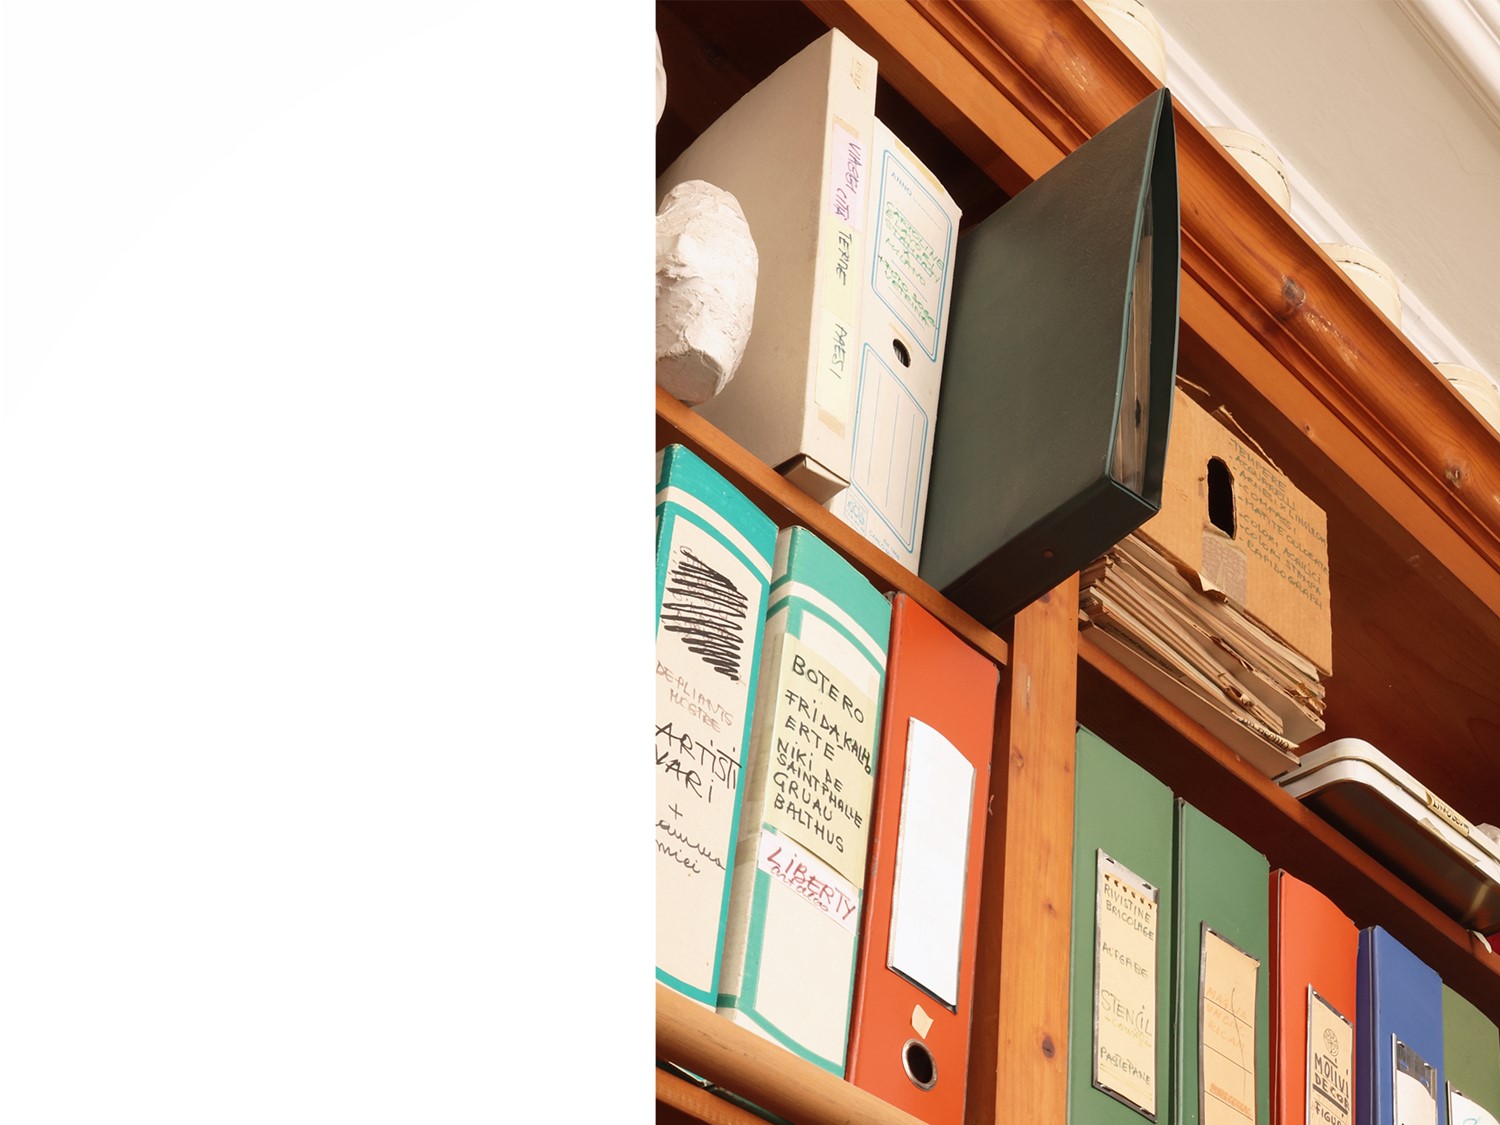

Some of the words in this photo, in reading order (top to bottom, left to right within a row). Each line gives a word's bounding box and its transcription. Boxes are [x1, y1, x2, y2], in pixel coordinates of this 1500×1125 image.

[792, 654, 864, 724] BOTERO
[774, 793, 844, 853] BALTHUS
[1104, 883, 1152, 923] RIVISTINE
